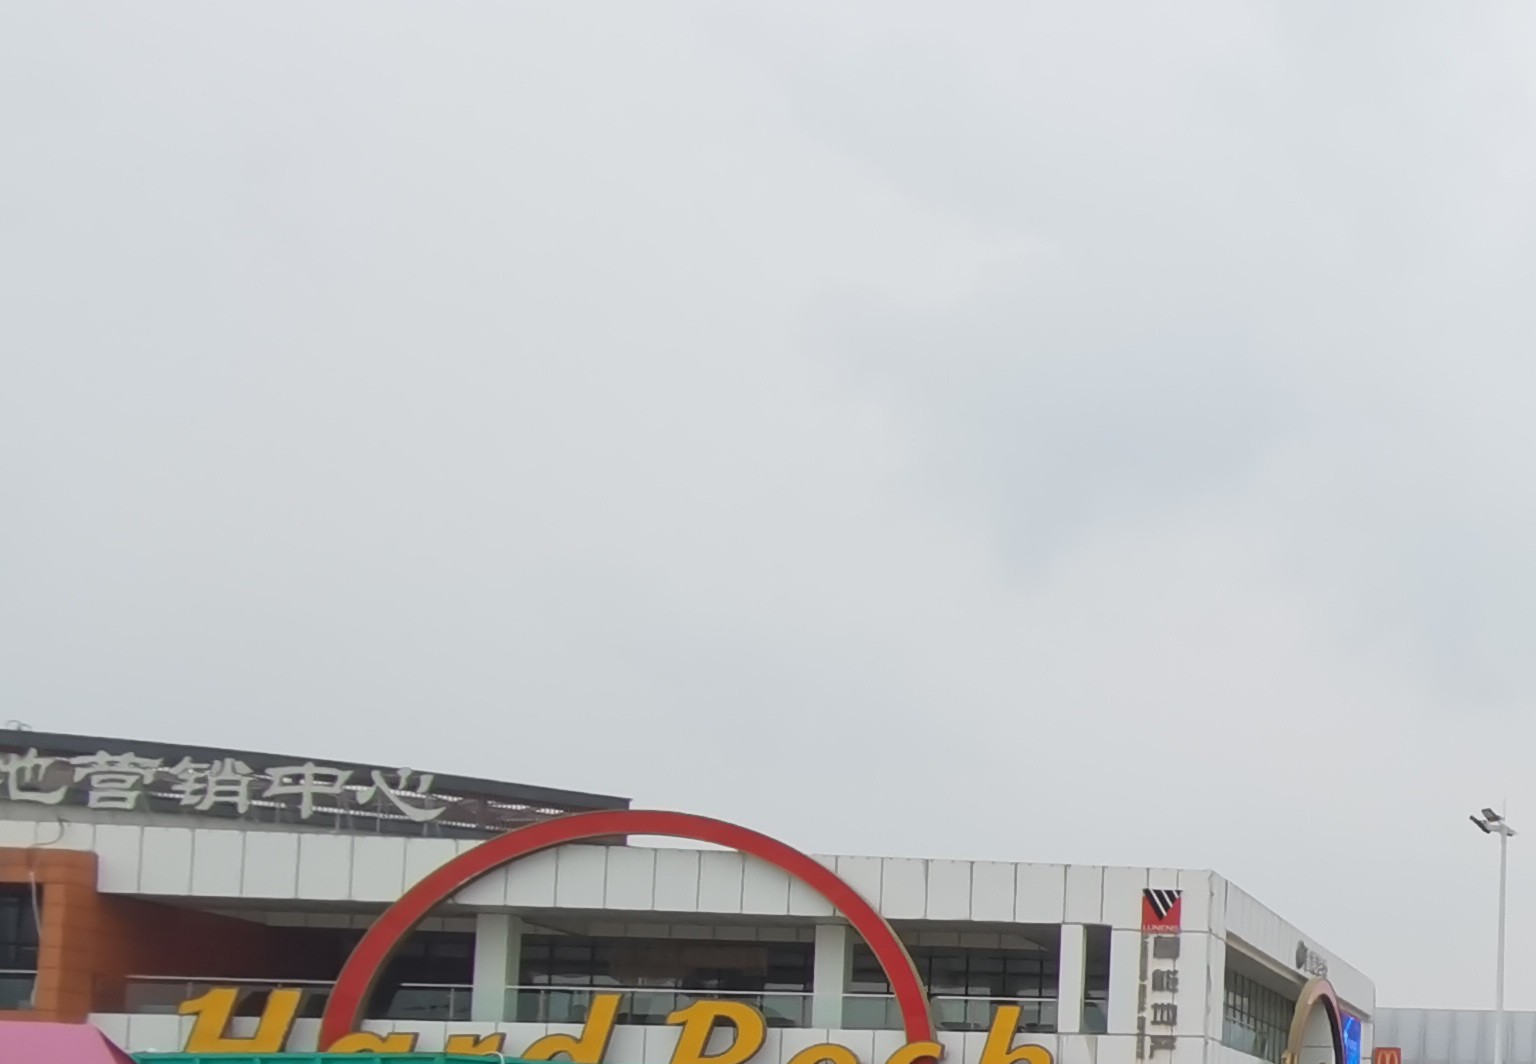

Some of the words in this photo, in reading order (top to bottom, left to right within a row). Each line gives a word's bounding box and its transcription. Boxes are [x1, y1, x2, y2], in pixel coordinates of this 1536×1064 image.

[0, 748, 447, 823] 地营销中心
[177, 987, 625, 1064] Hd
